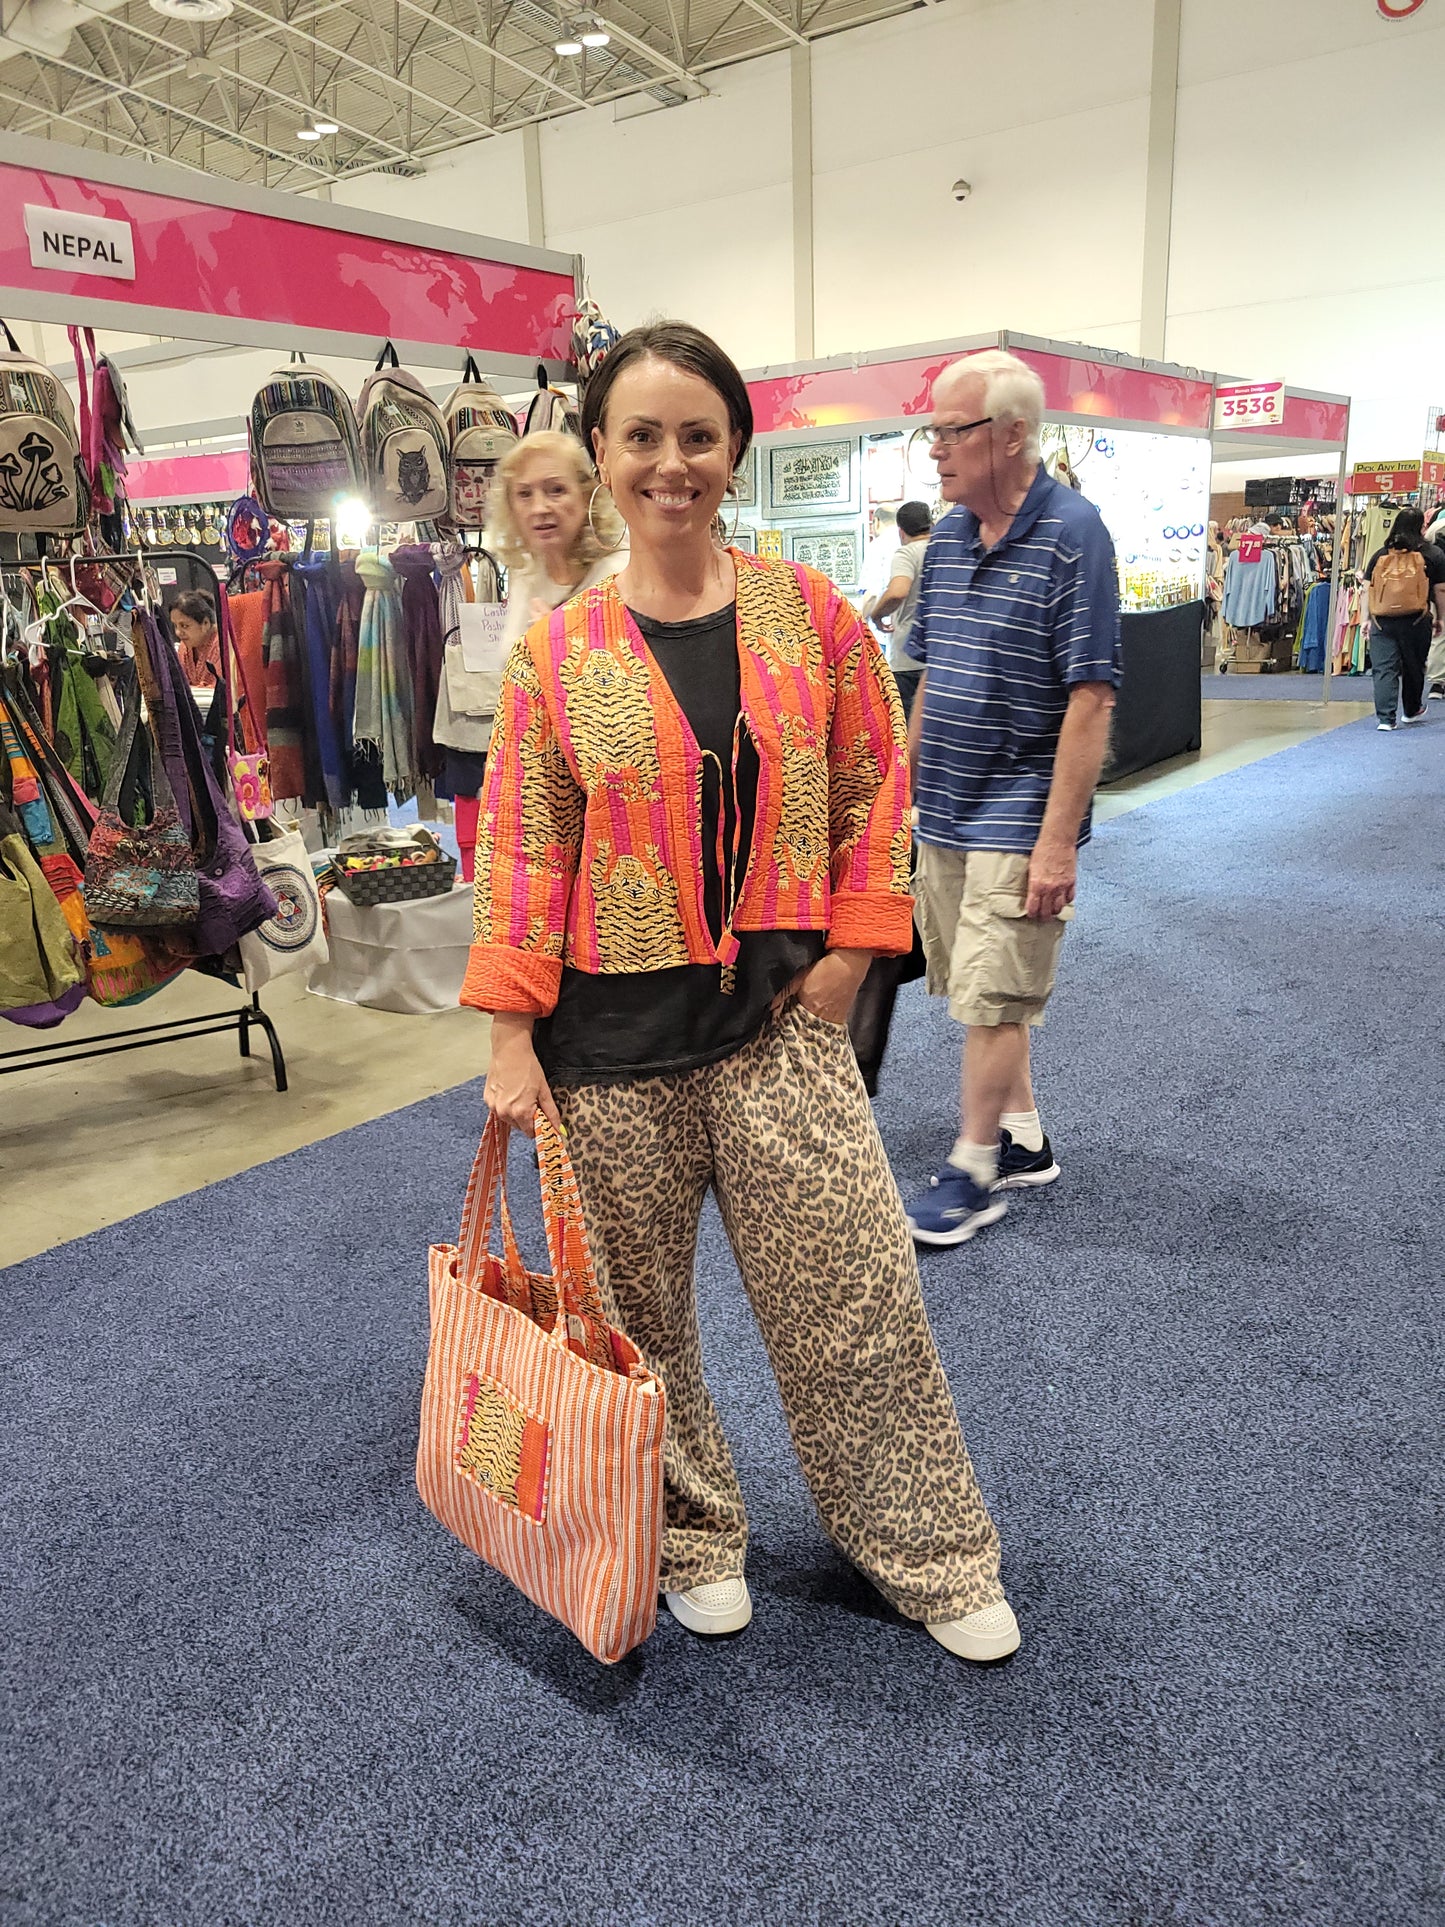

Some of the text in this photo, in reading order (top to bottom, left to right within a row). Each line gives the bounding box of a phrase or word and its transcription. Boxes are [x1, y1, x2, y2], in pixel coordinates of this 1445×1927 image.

[42, 230, 123, 264] NEPAL
[1222, 395, 1275, 417] 3536
[1356, 462, 1416, 472] PICK ANY ITEM
[1375, 474, 1394, 491] $5
